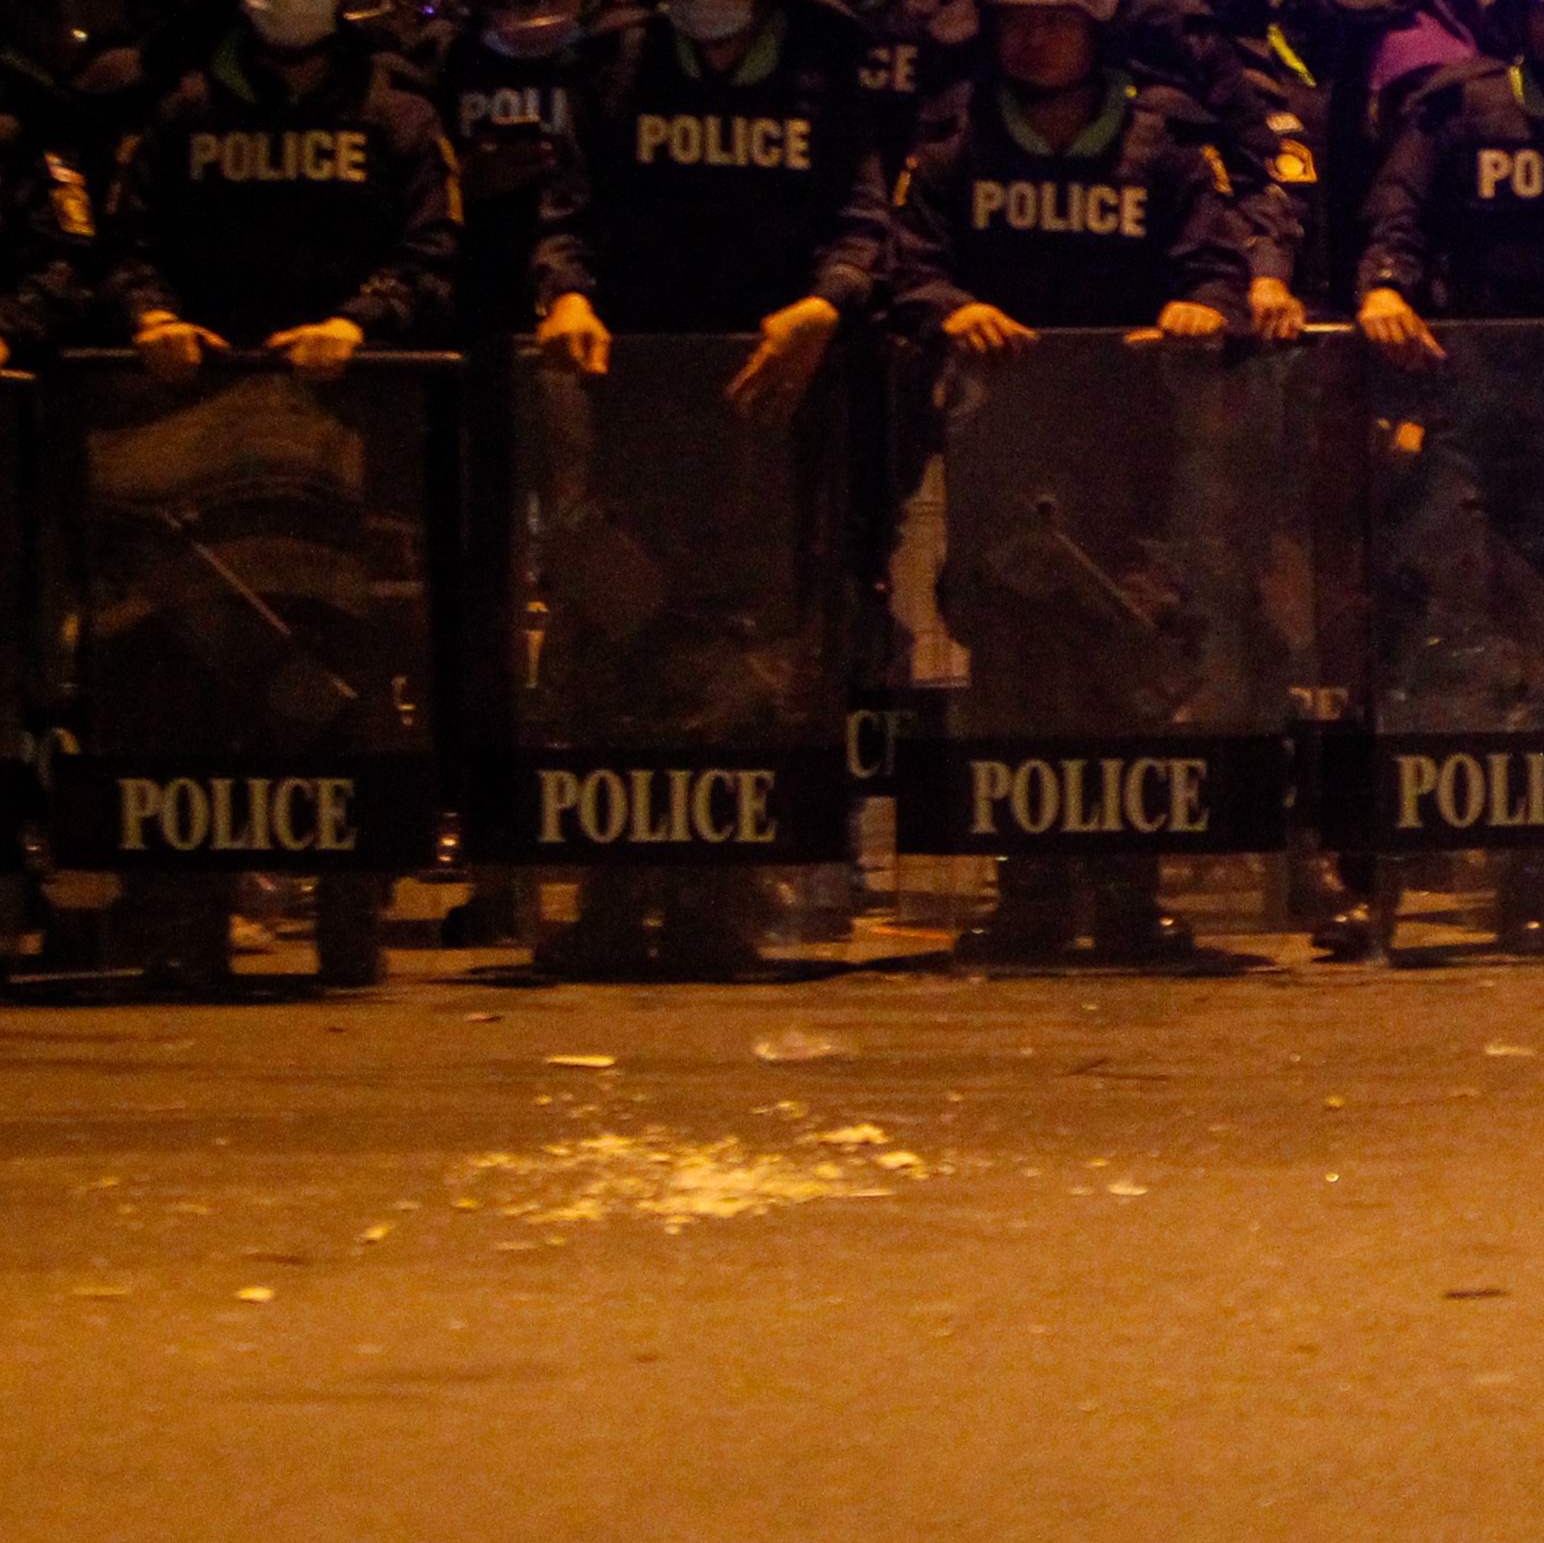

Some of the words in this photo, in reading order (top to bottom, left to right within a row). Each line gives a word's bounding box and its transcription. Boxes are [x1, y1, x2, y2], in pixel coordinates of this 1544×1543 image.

[192, 131, 367, 182] POLICE
[638, 115, 810, 169] POLICE
[974, 181, 1146, 236] POLICE
[120, 778, 353, 850] POLICE
[540, 769, 774, 842] POLICE
[972, 758, 1206, 833] POLICE
